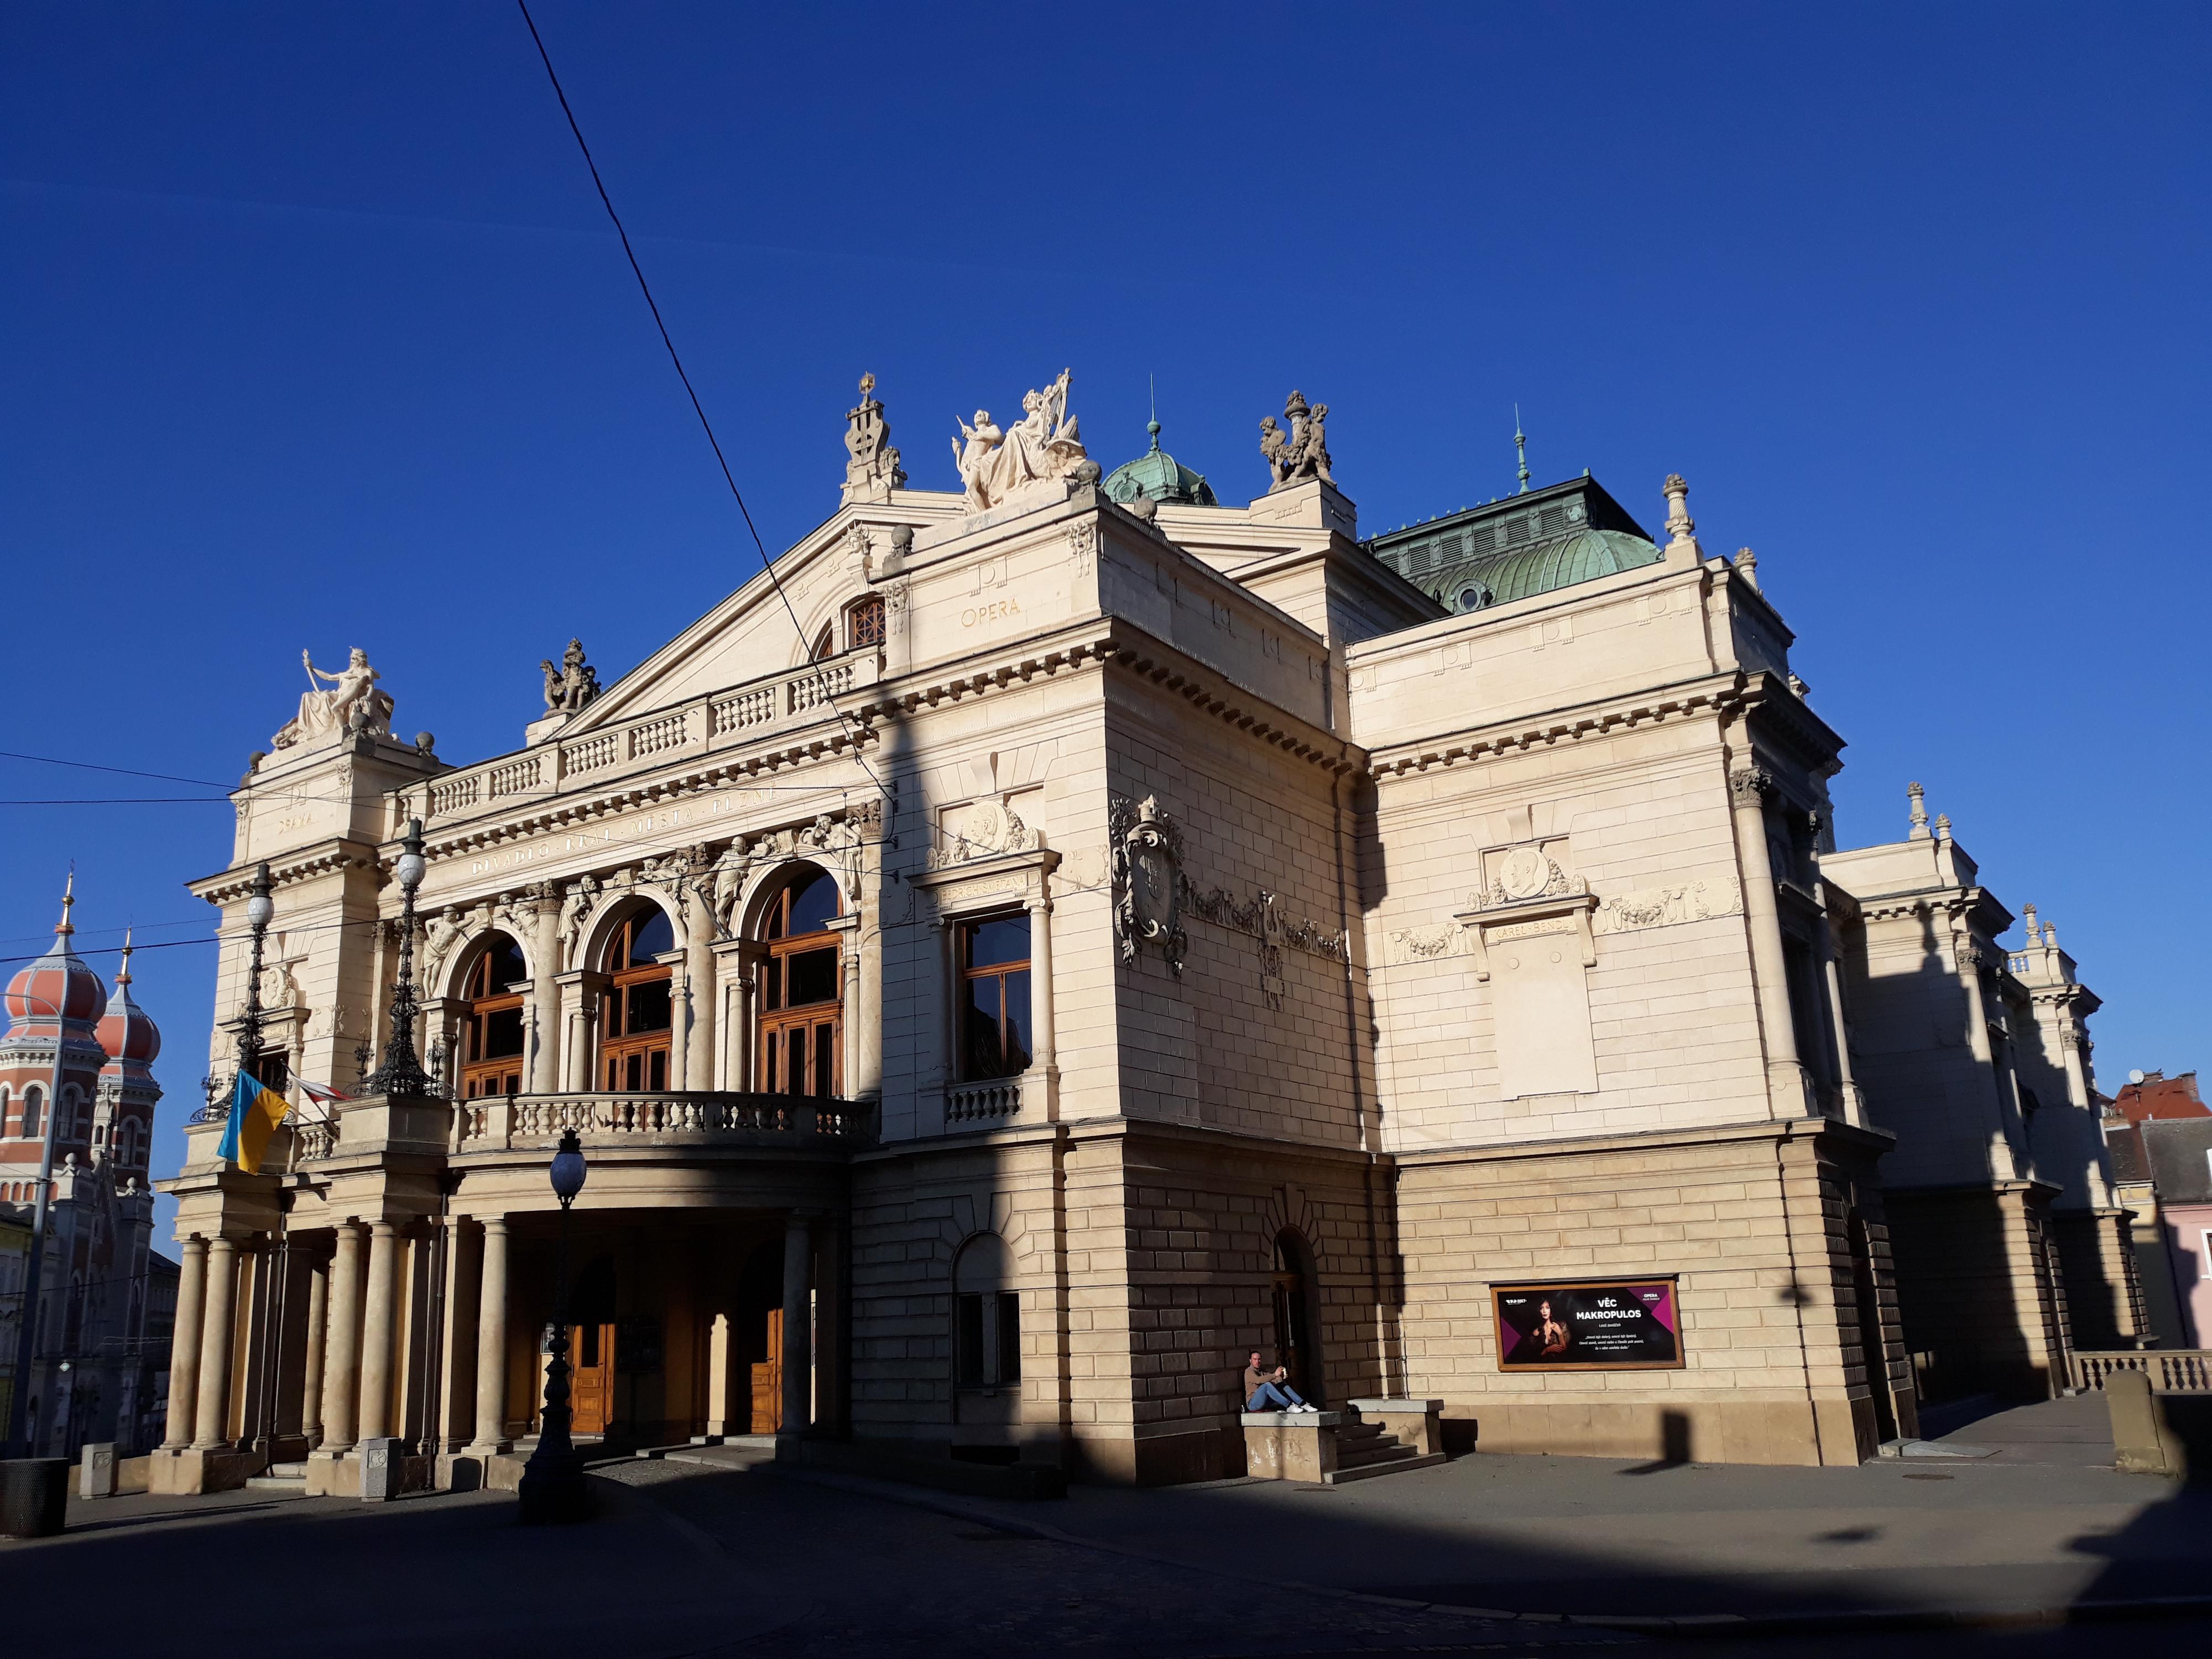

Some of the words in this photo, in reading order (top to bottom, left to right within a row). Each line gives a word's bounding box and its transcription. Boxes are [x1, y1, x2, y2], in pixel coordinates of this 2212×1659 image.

[961, 598, 1020, 627] OPERA
[472, 843, 549, 875] DIVADLO
[631, 807, 693, 834] MĚSTA
[1494, 926, 1527, 938] KAREL
[1533, 919, 1569, 933] BENDL
[1597, 1297, 1618, 1308] VĚC
[1576, 1310, 1642, 1320] MAKROPULOS
